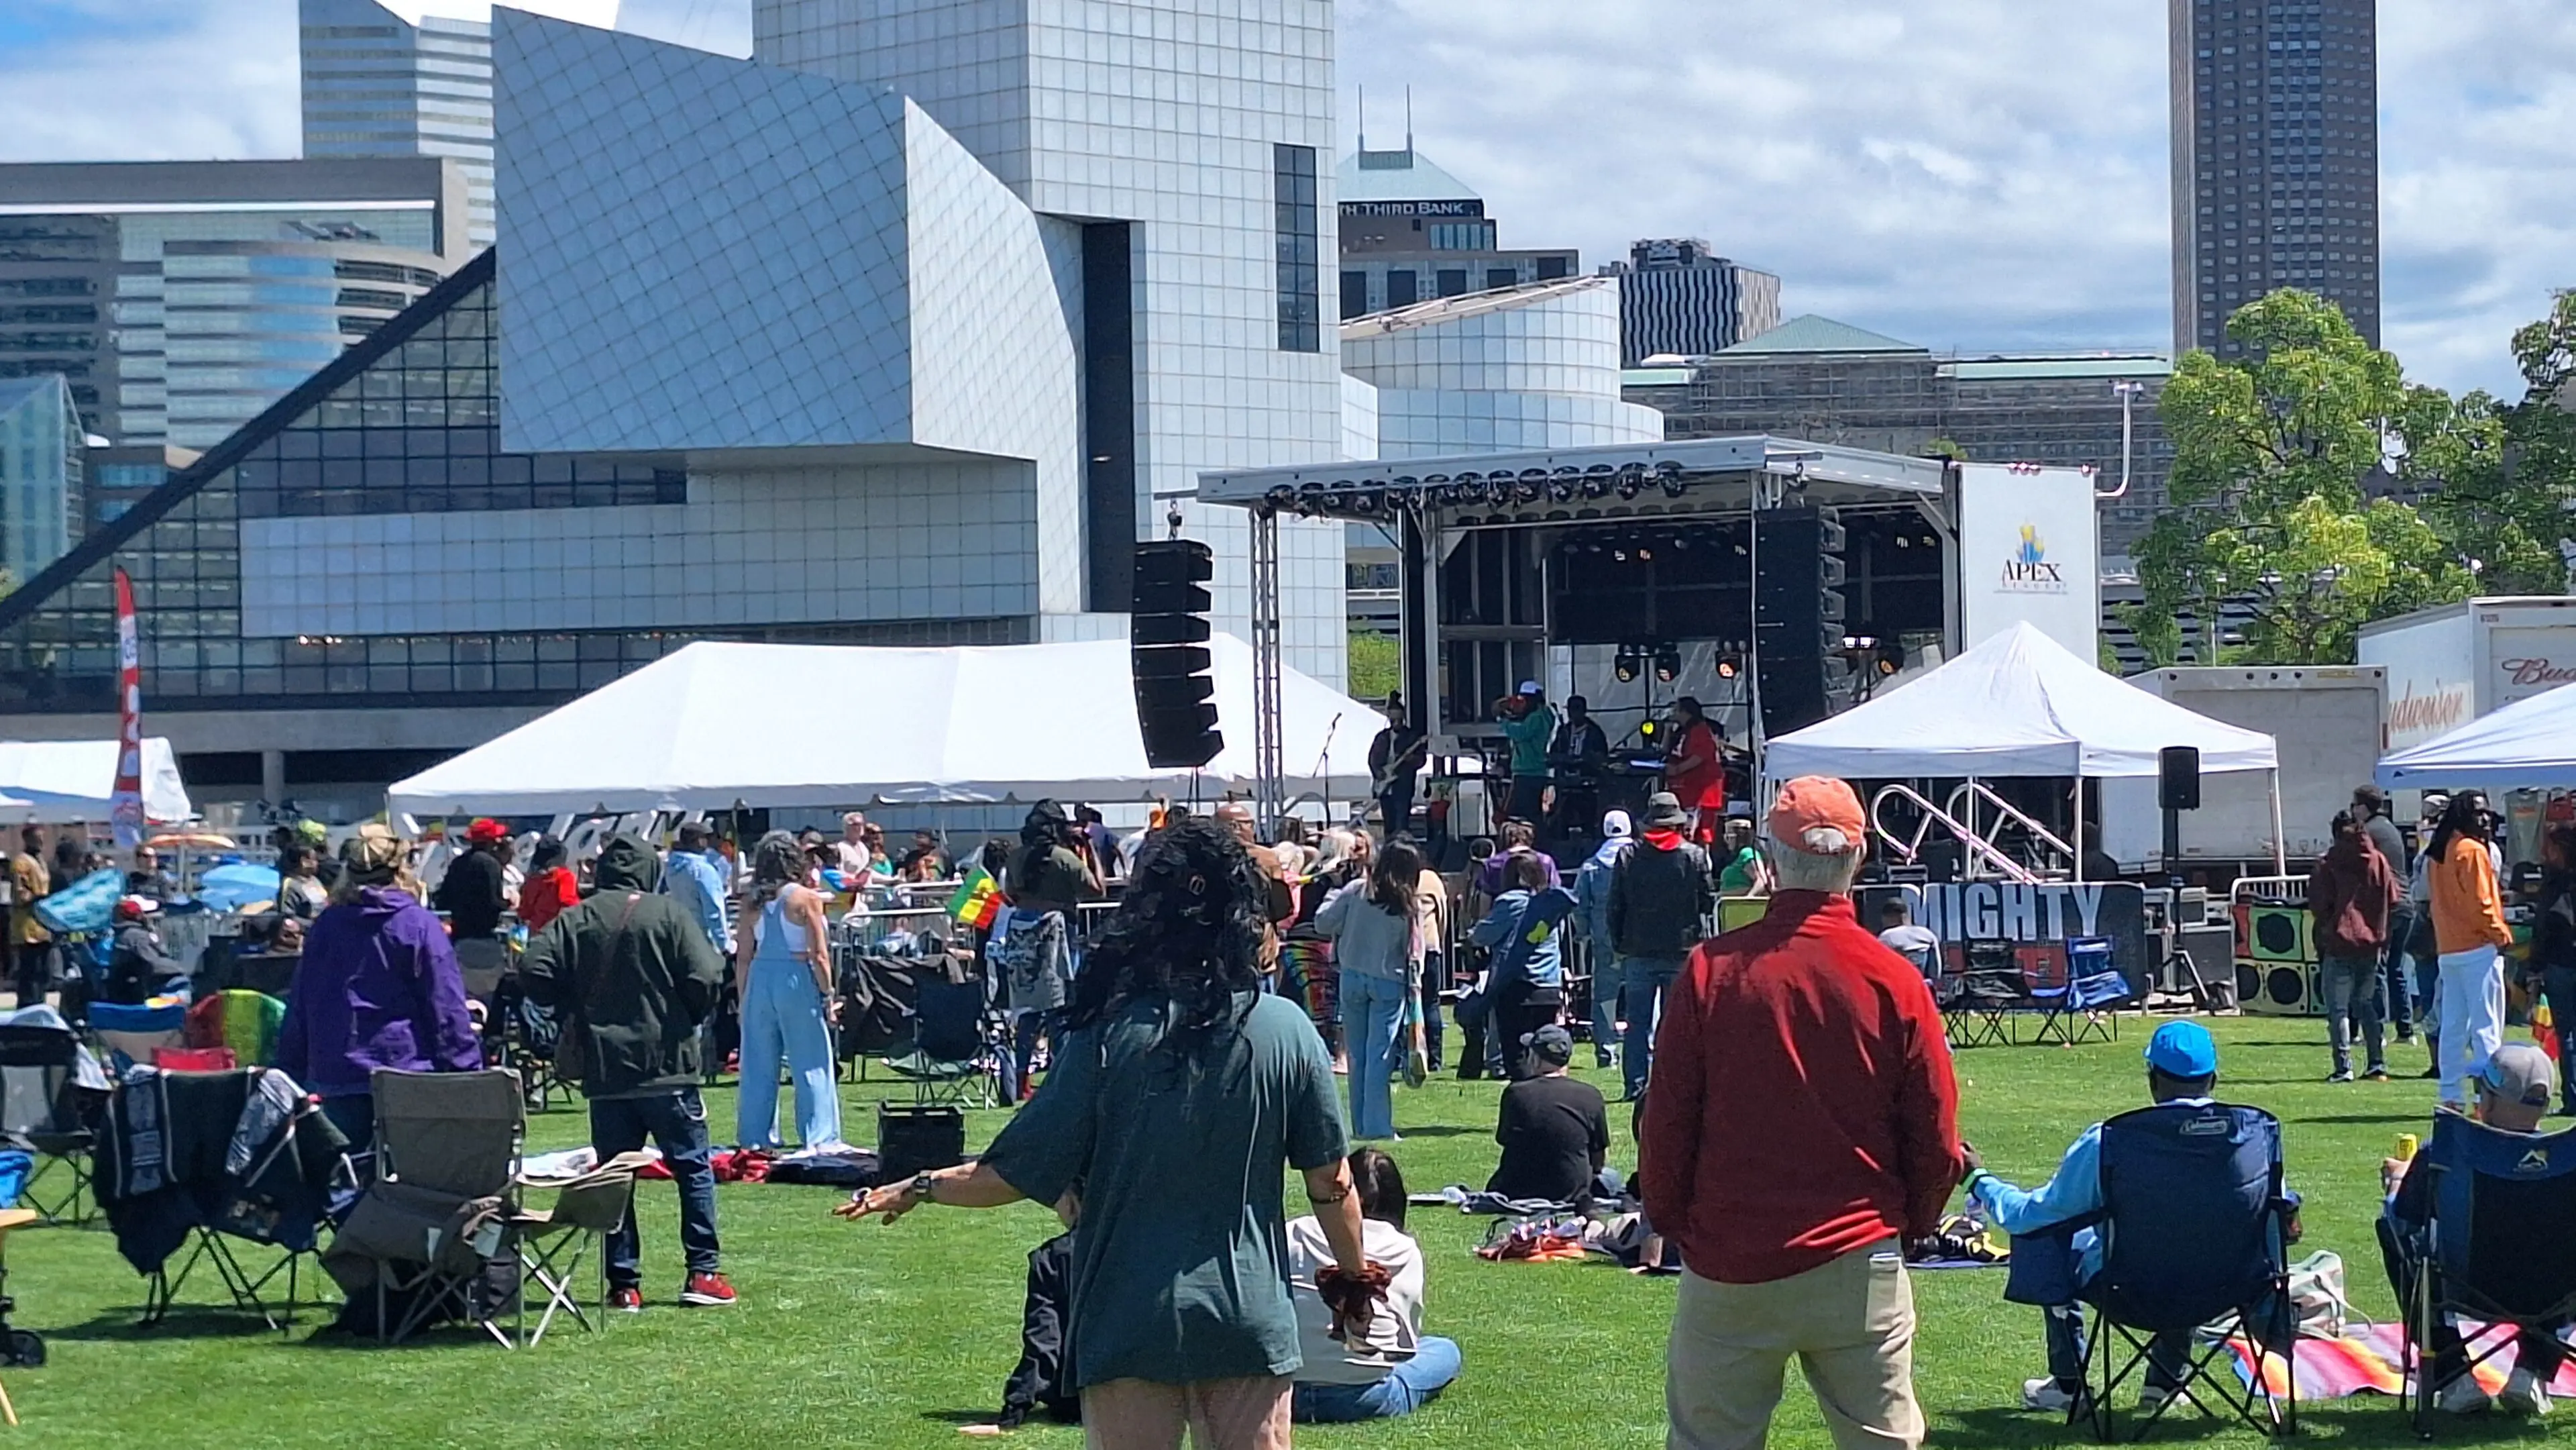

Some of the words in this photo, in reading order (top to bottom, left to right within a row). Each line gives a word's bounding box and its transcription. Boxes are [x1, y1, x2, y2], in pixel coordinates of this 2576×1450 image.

[1338, 204, 1356, 217] TH
[1362, 203, 1415, 216] THIRD
[1417, 202, 1464, 215] BANK
[2001, 559, 2061, 582] APEX
[1901, 882, 2104, 941] MIGHTY
